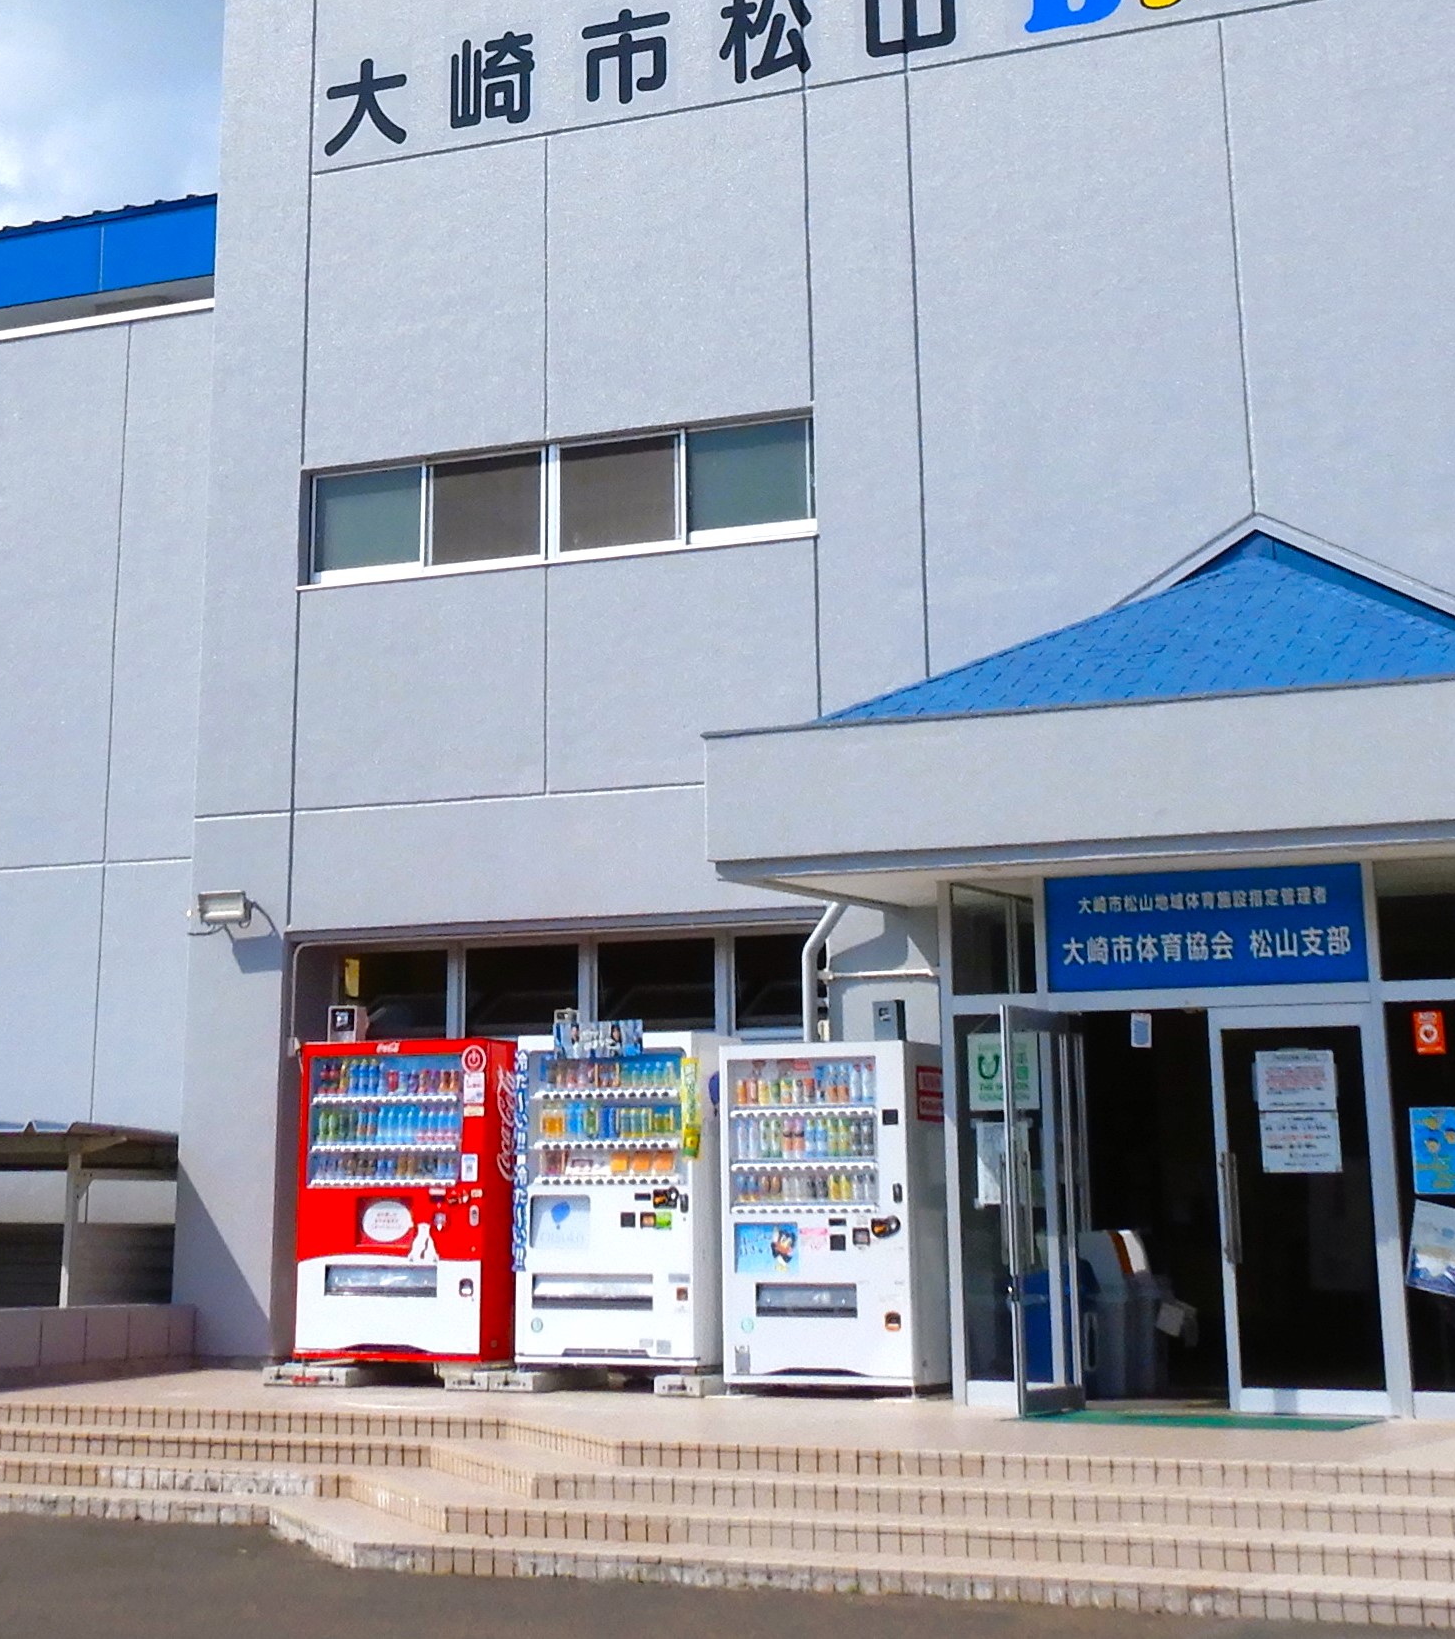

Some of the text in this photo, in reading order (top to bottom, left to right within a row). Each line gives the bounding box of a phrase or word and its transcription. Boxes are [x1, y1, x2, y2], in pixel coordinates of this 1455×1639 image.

[1062, 924, 1352, 967] 大崎市体育協会 松山支部
